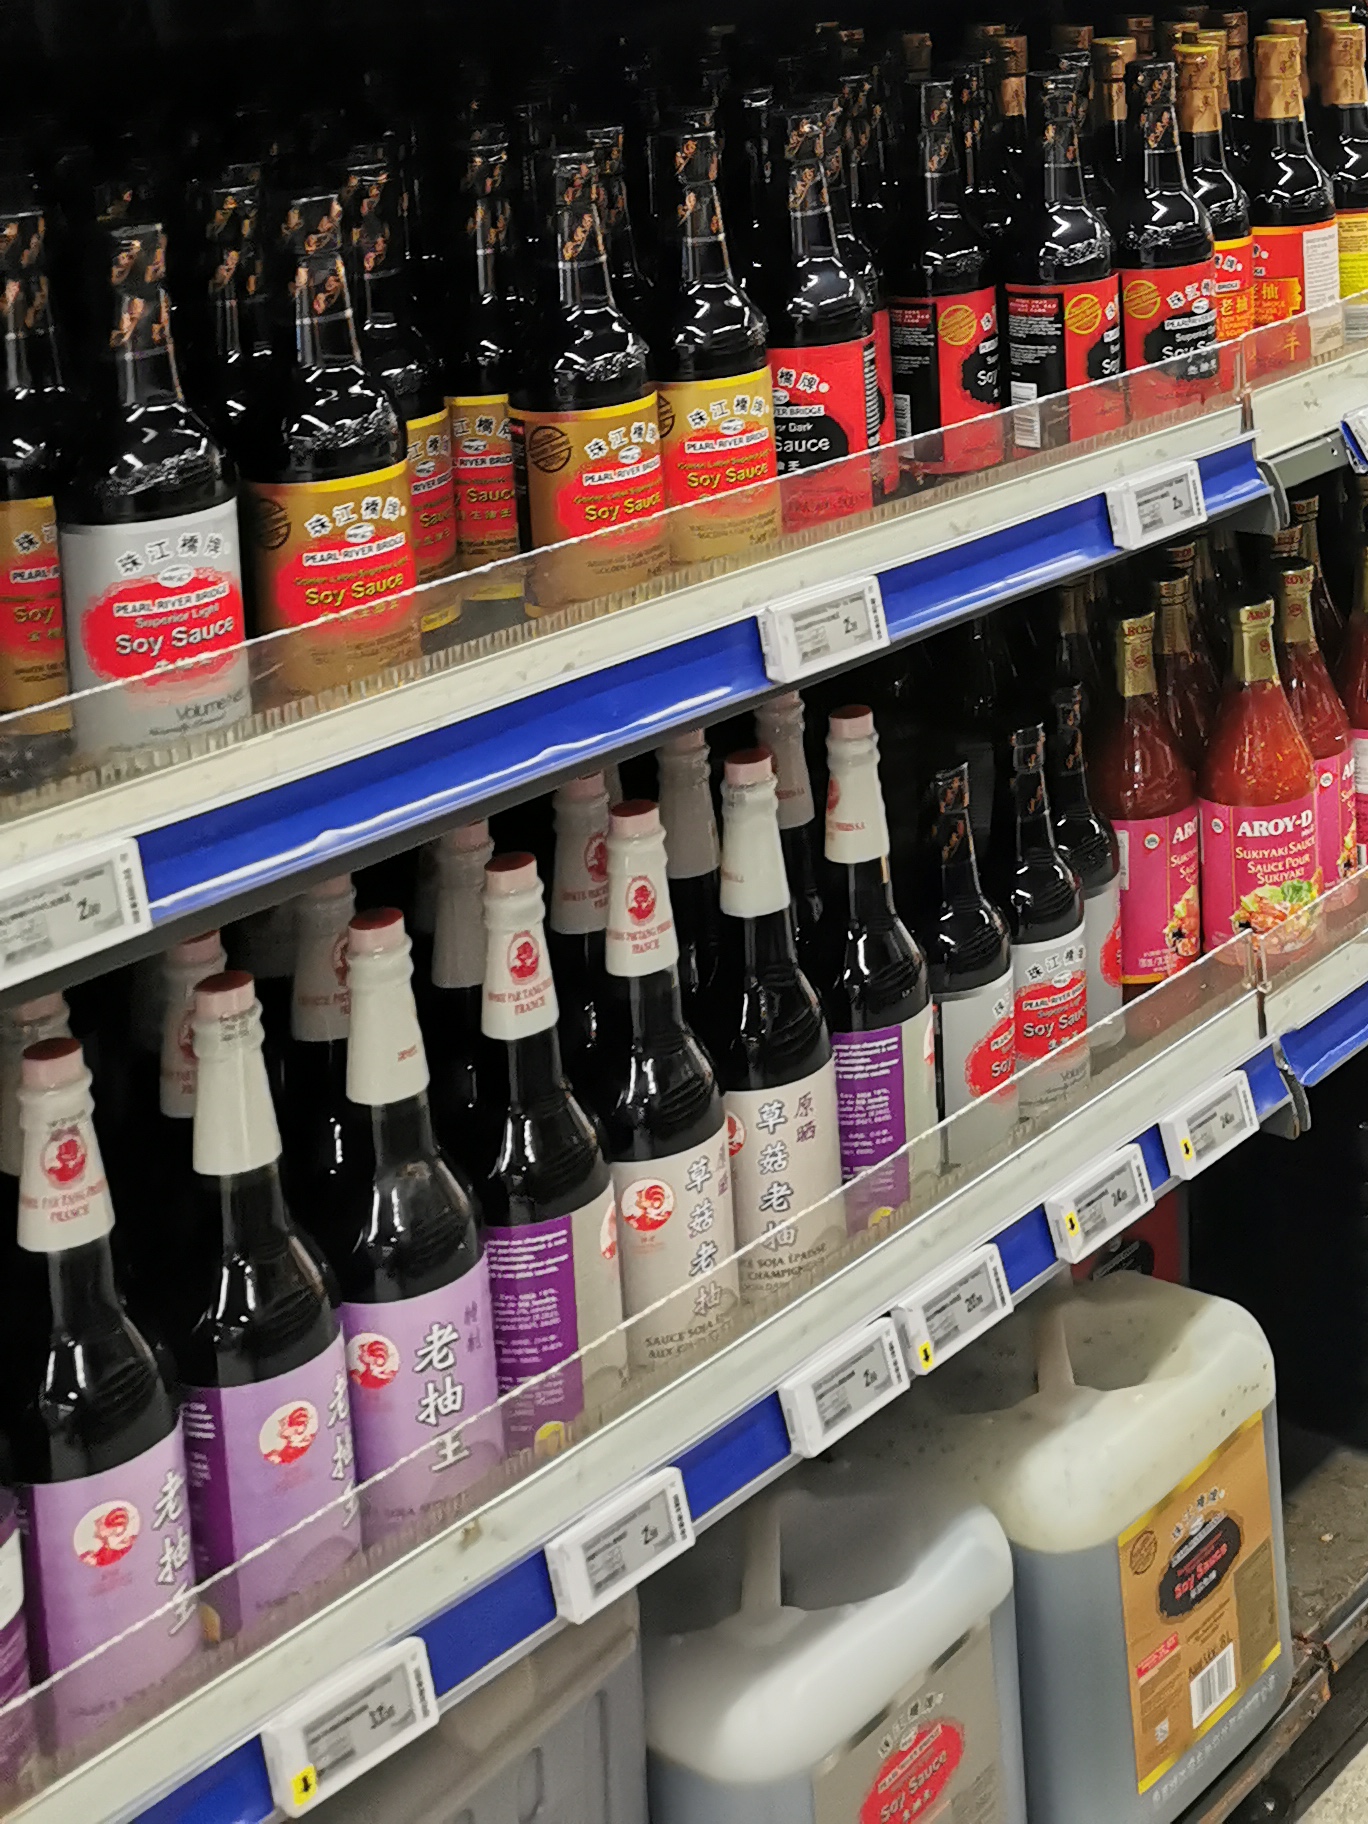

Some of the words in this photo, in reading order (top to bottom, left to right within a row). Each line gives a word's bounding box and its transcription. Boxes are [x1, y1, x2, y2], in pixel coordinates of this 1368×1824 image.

[789, 405, 824, 417] BRIDGE
[788, 421, 813, 434] Dark
[686, 440, 716, 453] PEARL
[718, 436, 744, 449] RIVER
[776, 436, 830, 453] Sauce
[459, 457, 486, 468] RIVER
[583, 473, 614, 485] PEARL
[617, 467, 640, 480] RIVER
[687, 470, 722, 490] Soy
[725, 462, 769, 484] Sauce
[584, 505, 620, 523] Soy
[623, 492, 662, 513] Sauce
[303, 551, 339, 566] PEARL
[341, 544, 374, 562] RIVER
[375, 532, 406, 552] BRIDGE
[11, 570, 47, 583] PEARL
[114, 600, 153, 618] PEARL
[156, 594, 193, 613] RIVER
[195, 582, 230, 604] BRIDGE
[304, 587, 346, 608] Soy
[350, 573, 405, 599] Sauce
[13, 605, 55, 625] Soy
[134, 612, 190, 630] Superior
[115, 632, 165, 659] Soy
[170, 615, 235, 649] Sauce
[1236, 809, 1313, 838] AROY-D
[1235, 845, 1288, 860] SUKIYAKI
[1288, 836, 1316, 853] SAUCE
[1247, 860, 1284, 875] SAUCE
[1285, 853, 1311, 868] POUR
[1257, 868, 1305, 884] SUKIYAKI
[1023, 997, 1051, 1011] PEARL
[1051, 992, 1072, 1006] RIVER
[1023, 1021, 1056, 1039] Soy
[757, 1098, 800, 1253] 草菇老抽
[645, 1331, 686, 1348] SAUCE
[413, 1320, 472, 1473] 老抽王
[1174, 1573, 1195, 1601] Soy
[1195, 1542, 1228, 1581] Sauce
[879, 1791, 906, 1824] Soy
[907, 1749, 948, 1796] Sauce
